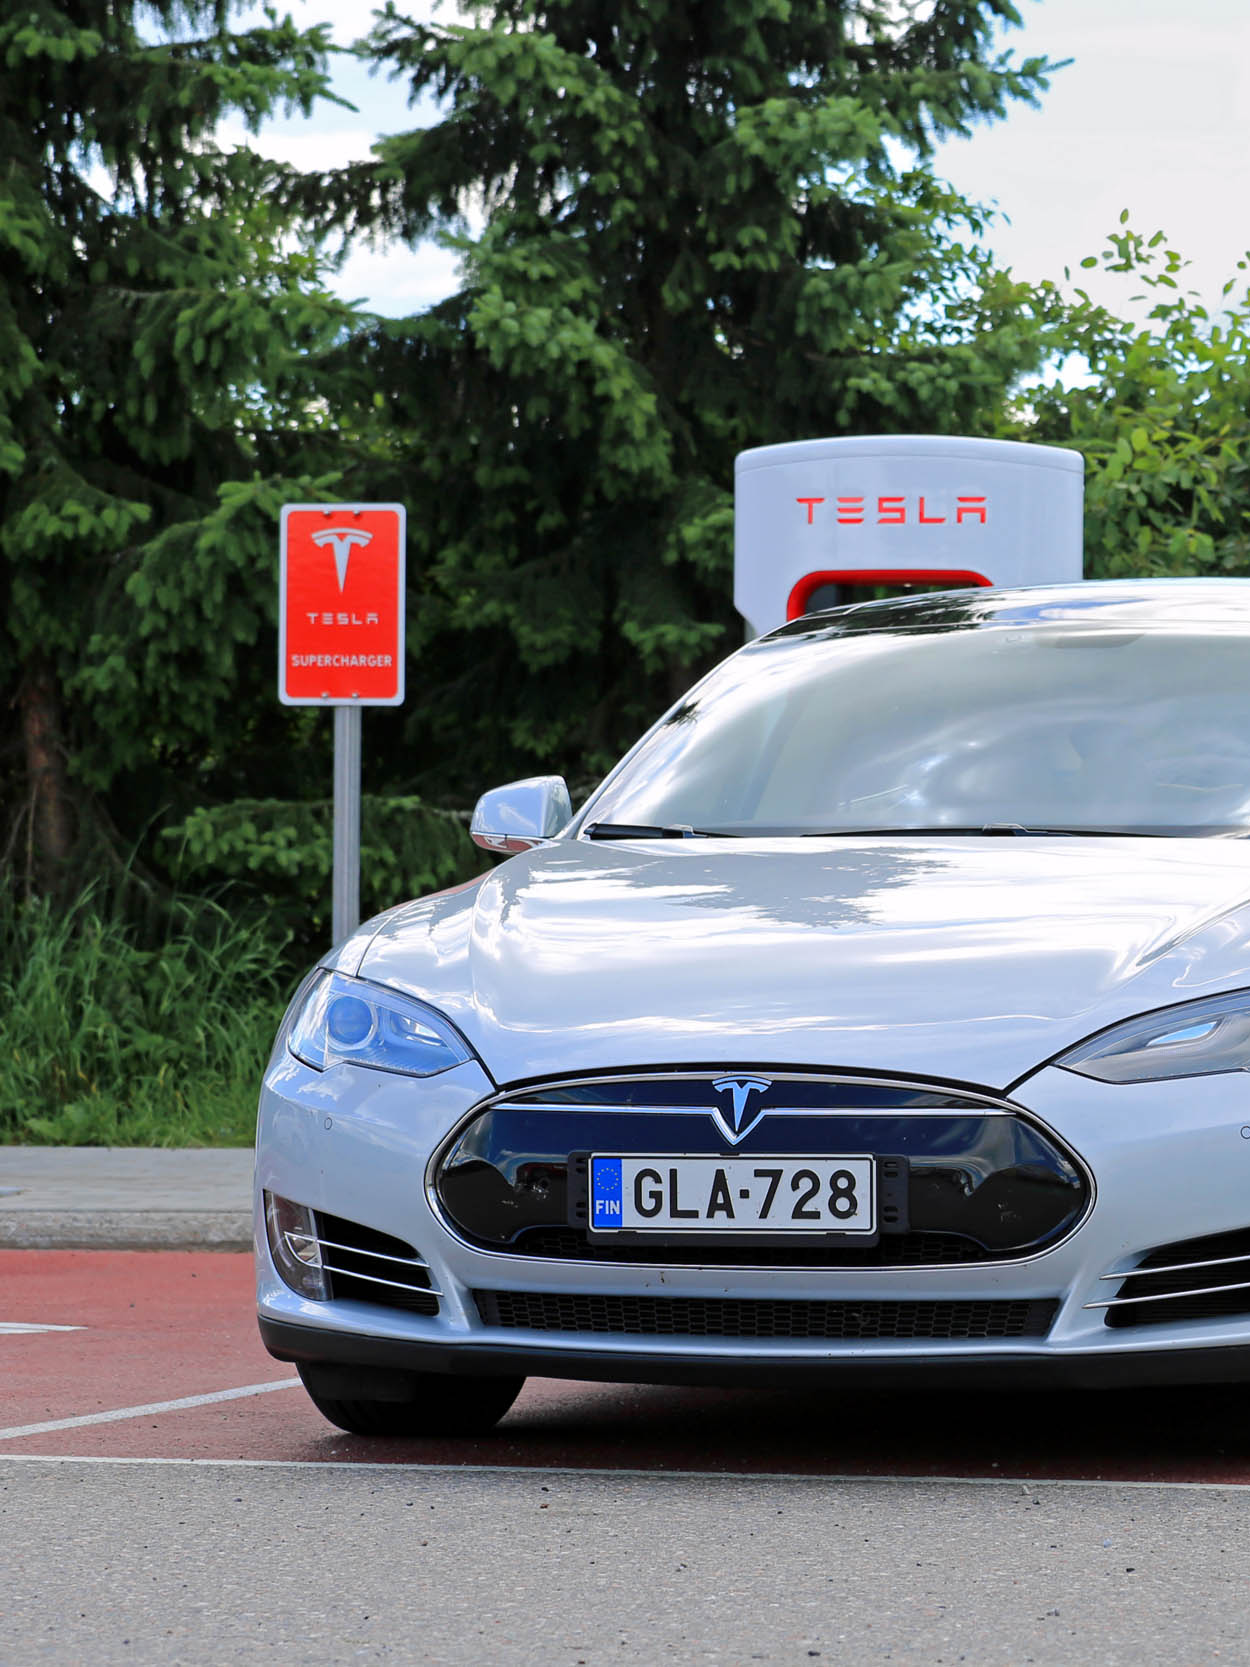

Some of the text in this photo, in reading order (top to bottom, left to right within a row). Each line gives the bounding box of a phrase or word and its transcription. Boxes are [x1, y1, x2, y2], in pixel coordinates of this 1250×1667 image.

[796, 496, 987, 525] TESLA
[306, 612, 379, 625] TESLA
[291, 655, 393, 668] SUPERCHARGER
[596, 1168, 858, 1220] FIN GLA-728
